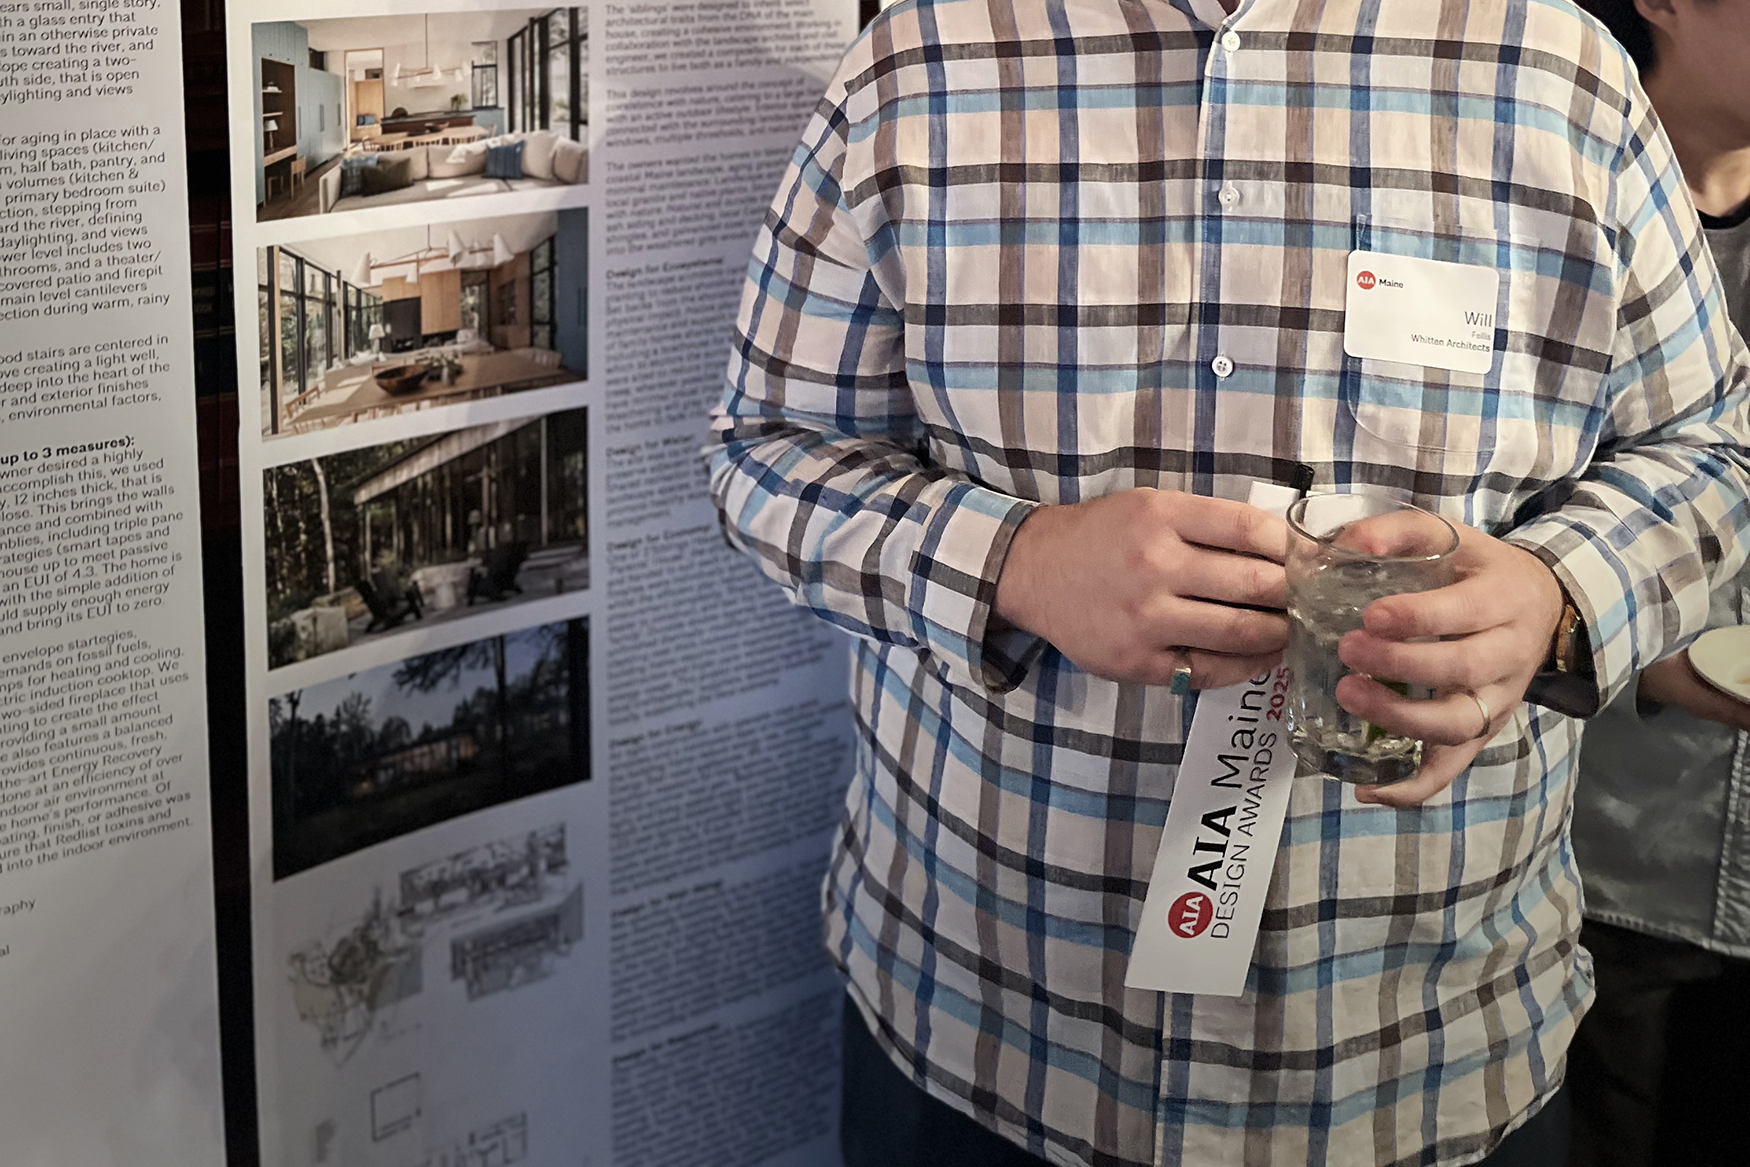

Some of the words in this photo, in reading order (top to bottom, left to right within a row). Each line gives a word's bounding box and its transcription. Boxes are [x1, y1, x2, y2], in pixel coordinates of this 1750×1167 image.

[34, 0, 75, 12] small,
[16, 17, 25, 26] a
[29, 15, 66, 29] glass
[69, 13, 105, 26] entry
[109, 12, 136, 23] that
[2, 32, 15, 42] in
[19, 32, 36, 42] an
[41, 28, 108, 41] otherwise
[112, 25, 159, 40] private
[12, 43, 60, 56] toward
[65, 42, 87, 54] the
[91, 42, 125, 53] river,
[129, 39, 154, 51] and
[32, 57, 89, 71] creating
[92, 58, 101, 67] a
[105, 56, 137, 67] two-
[23, 73, 55, 86] side,
[60, 72, 88, 83] that
[91, 71, 103, 82] is
[106, 70, 140, 82] open
[66, 85, 92, 98] and
[95, 84, 133, 96] views
[1379, 279, 1404, 288] Maine
[1464, 311, 1492, 328] Will
[1411, 334, 1444, 347] Whitten
[1446, 339, 1490, 352] Architects
[1471, 330, 1491, 341] Fellis
[8, 397, 108, 422] environmental
[112, 393, 162, 406] factors,
[0, 452, 19, 466] up
[23, 451, 39, 460] to
[42, 447, 52, 459] 3
[56, 435, 135, 456] measures):
[2, 643, 64, 664] envelope
[68, 629, 137, 651] startegies,
[1211, 844, 1251, 940] DESIGN
[1237, 732, 1278, 837] AWARDS
[1266, 666, 1290, 722] 2025
[7, 858, 33, 872] into
[37, 853, 59, 865] the
[62, 840, 105, 858] indoor
[108, 818, 194, 846] environment.
[1187, 805, 1238, 892] AIA
